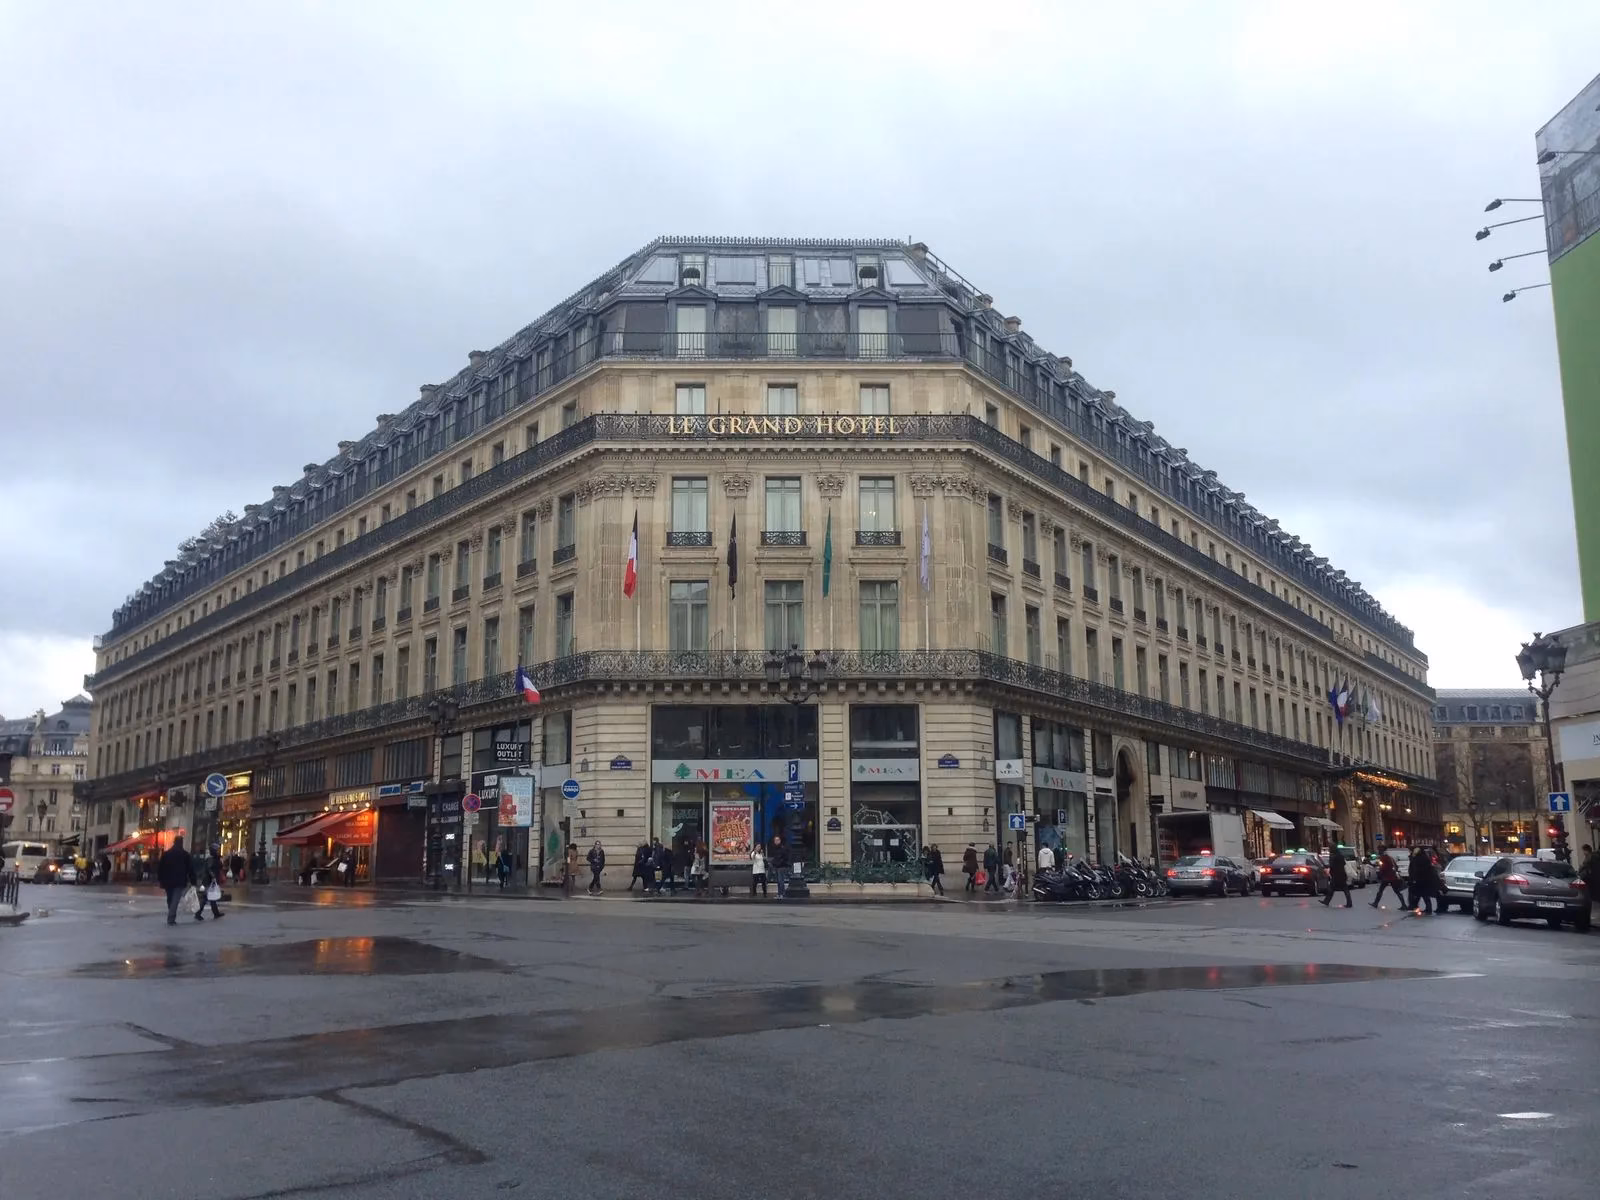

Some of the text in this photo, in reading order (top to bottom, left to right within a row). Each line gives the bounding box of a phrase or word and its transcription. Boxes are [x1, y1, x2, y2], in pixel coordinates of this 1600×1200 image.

[668, 415, 900, 434] LE GRAND HOTEL
[695, 768, 765, 780] MEA
[790, 763, 796, 778] P
[478, 788, 499, 800] LUXURY
